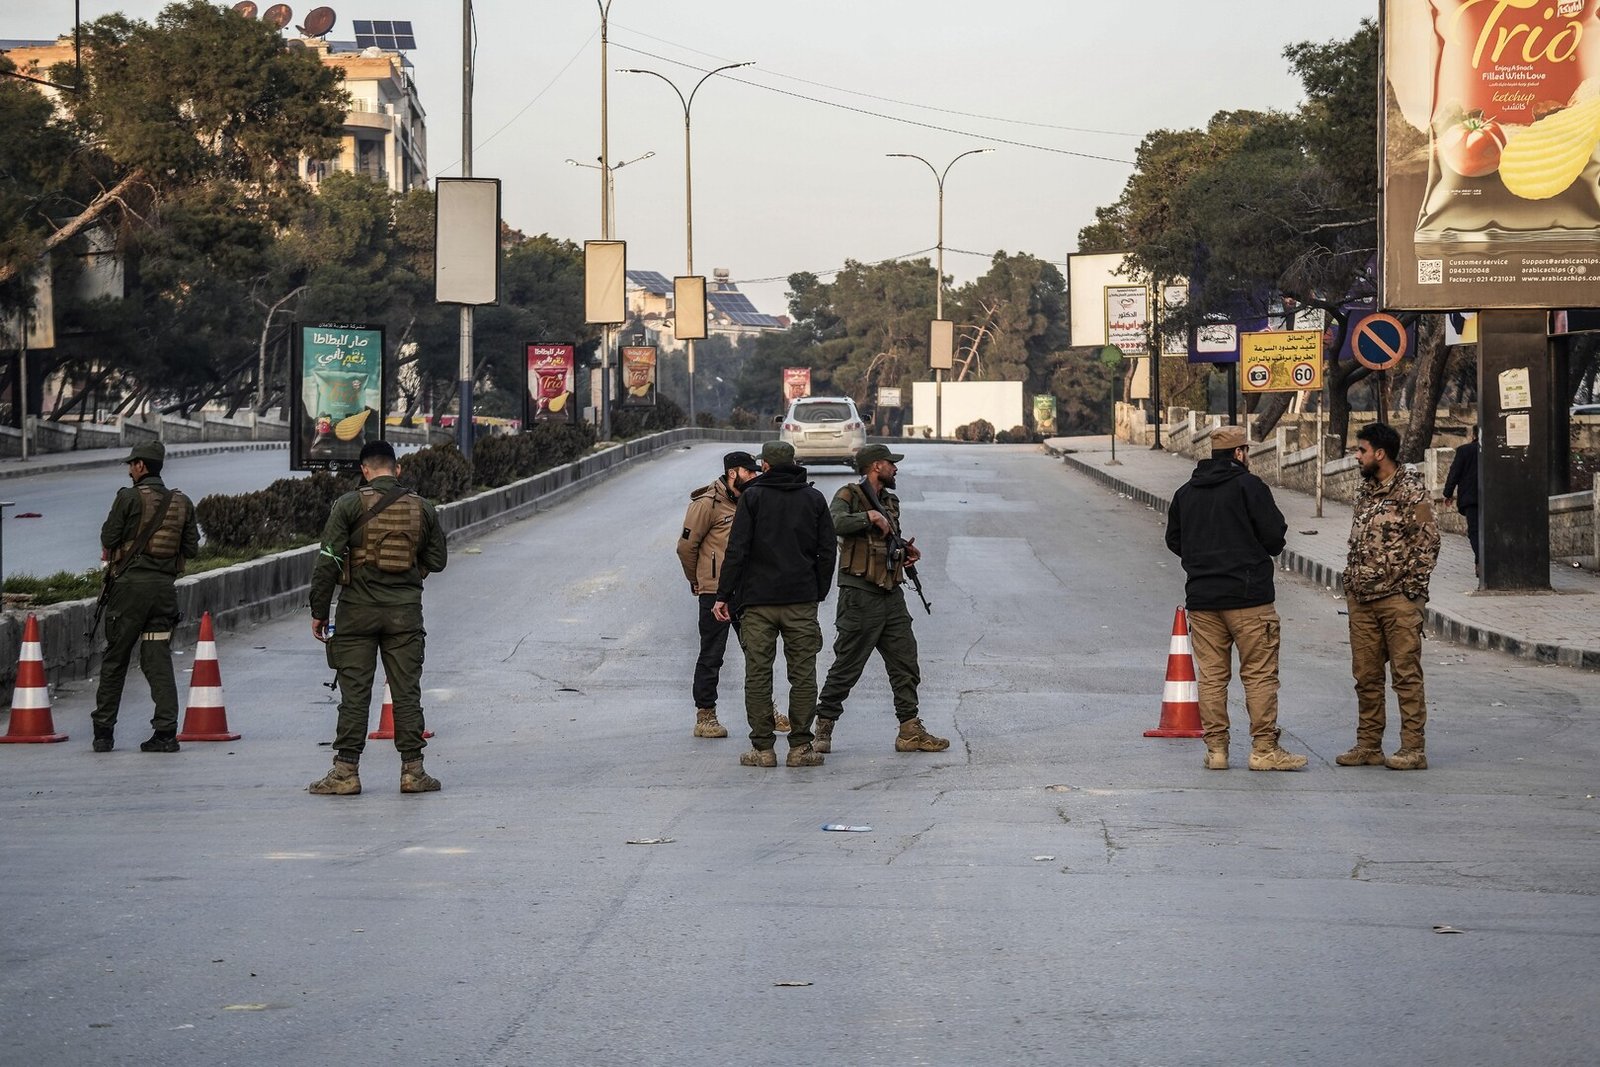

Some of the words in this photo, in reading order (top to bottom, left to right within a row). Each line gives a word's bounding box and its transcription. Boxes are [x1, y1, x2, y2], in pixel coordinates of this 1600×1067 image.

[1452, 0, 1584, 69] Trio
[1482, 71, 1505, 80] Filled
[1505, 71, 1526, 80] With
[1526, 71, 1546, 80] Love
[1491, 90, 1536, 105] ketchup
[313, 333, 348, 347] للبطاطا
[348, 335, 368, 348] صار
[1295, 368, 1312, 381] 60
